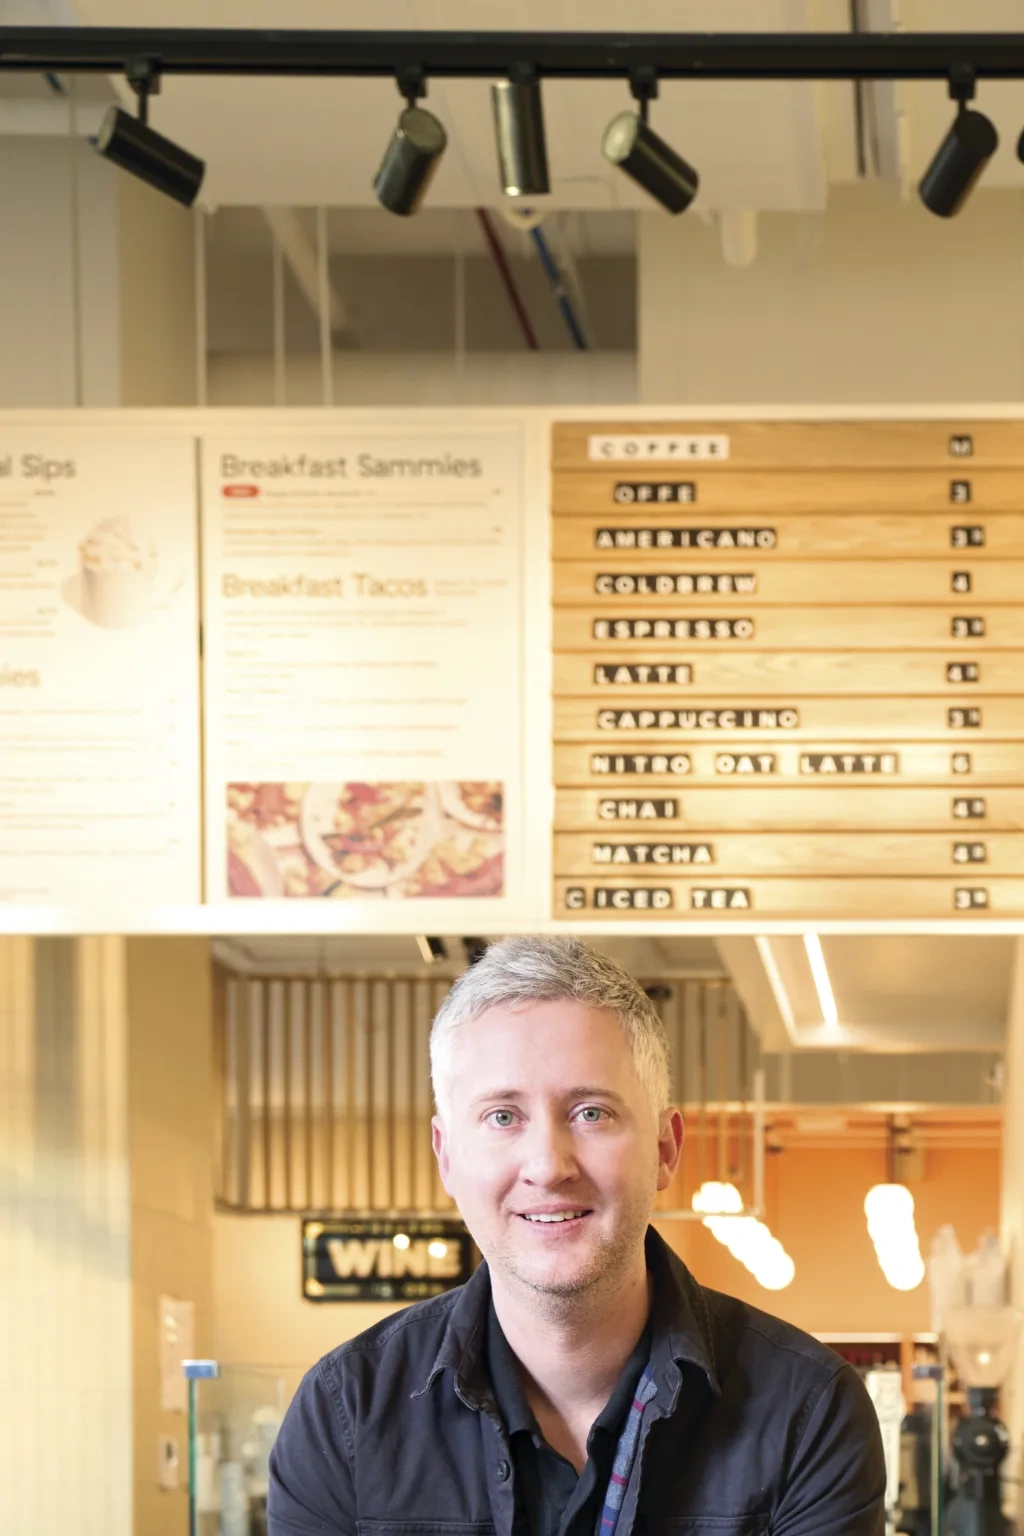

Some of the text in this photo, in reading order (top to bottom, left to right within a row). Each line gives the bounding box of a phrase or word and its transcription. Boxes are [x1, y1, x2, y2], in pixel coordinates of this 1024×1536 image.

[600, 442, 719, 458] COFFEE
[21, 454, 77, 484] Sips
[221, 453, 482, 479] Breakfast Sammies
[596, 529, 776, 548] AMERICANO
[222, 573, 341, 599] Breakfast
[353, 573, 428, 599] Tacos
[596, 575, 756, 594] COLDBREW
[594, 620, 753, 639] ESPRESSO
[596, 665, 691, 684] LATTE
[599, 710, 798, 729] CAPPUCCINO
[593, 755, 896, 774] NITRO OAT LATTE
[599, 801, 676, 819] CHAI
[593, 846, 712, 863] MATCHA
[596, 890, 672, 909] ICED
[692, 890, 749, 909] TEA
[326, 1238, 461, 1279] WINE
